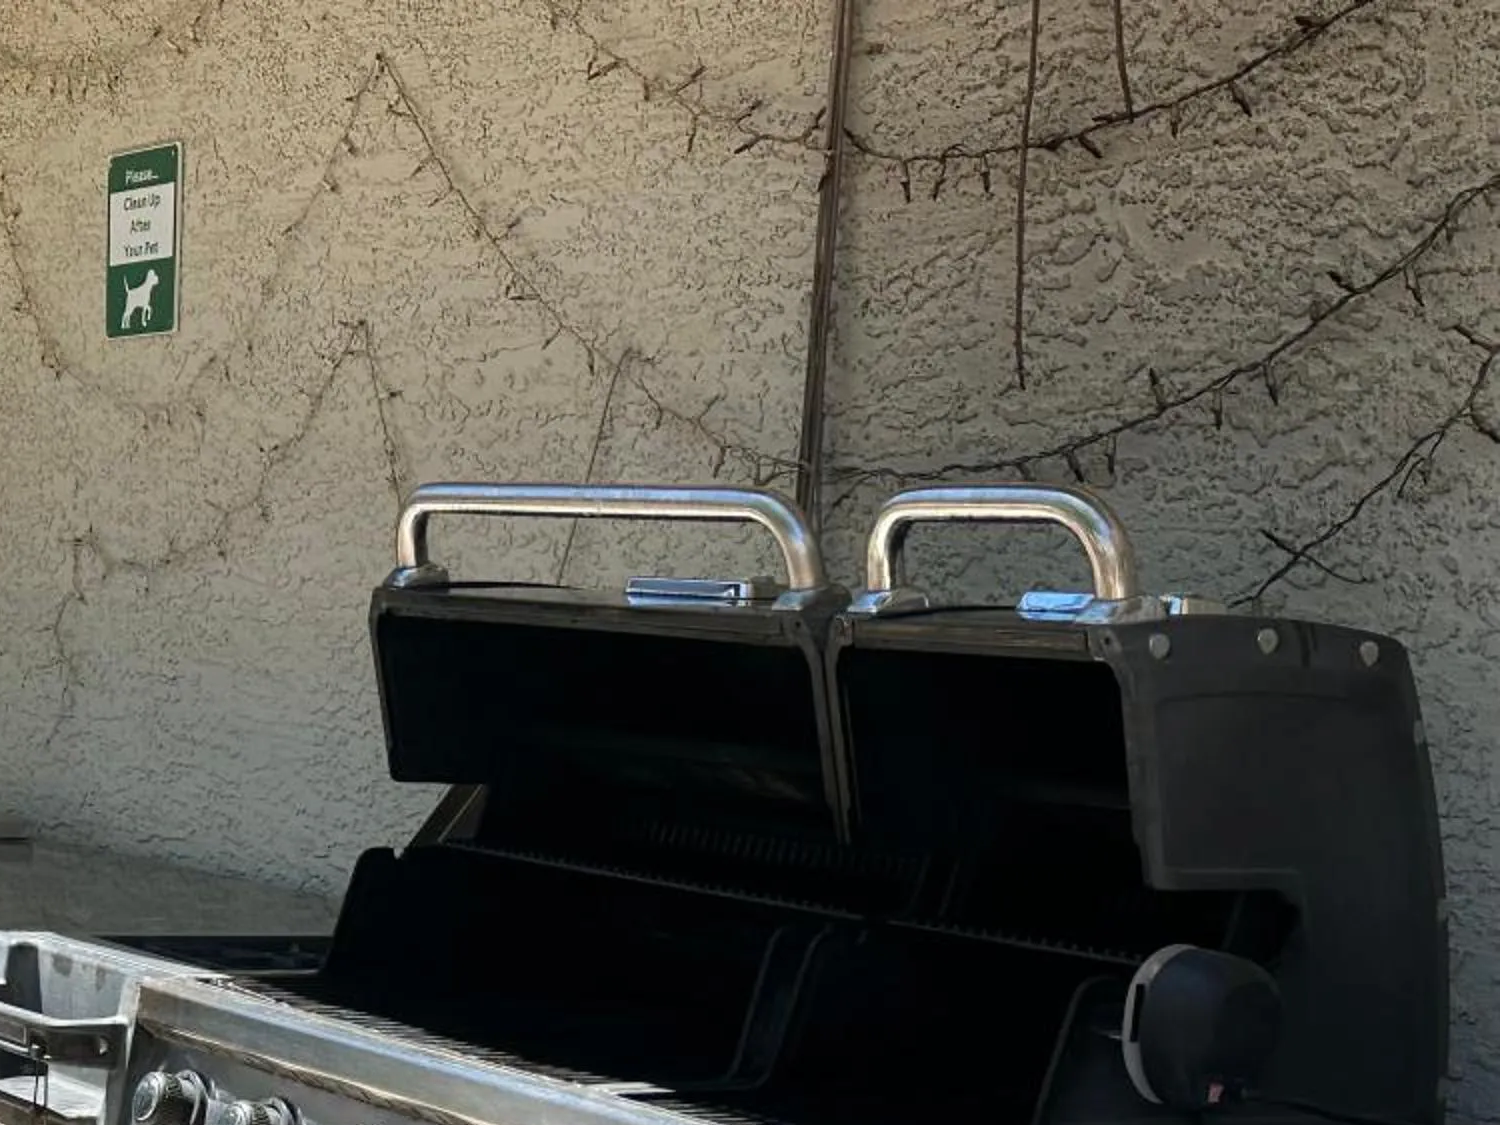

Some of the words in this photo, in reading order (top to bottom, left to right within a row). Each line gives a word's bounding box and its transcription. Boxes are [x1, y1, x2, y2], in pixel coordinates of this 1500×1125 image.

[123, 196, 147, 211] Clean
[148, 192, 161, 208] Up
[130, 219, 151, 234] After
[123, 243, 143, 257] Your
[144, 241, 159, 255] Pet
